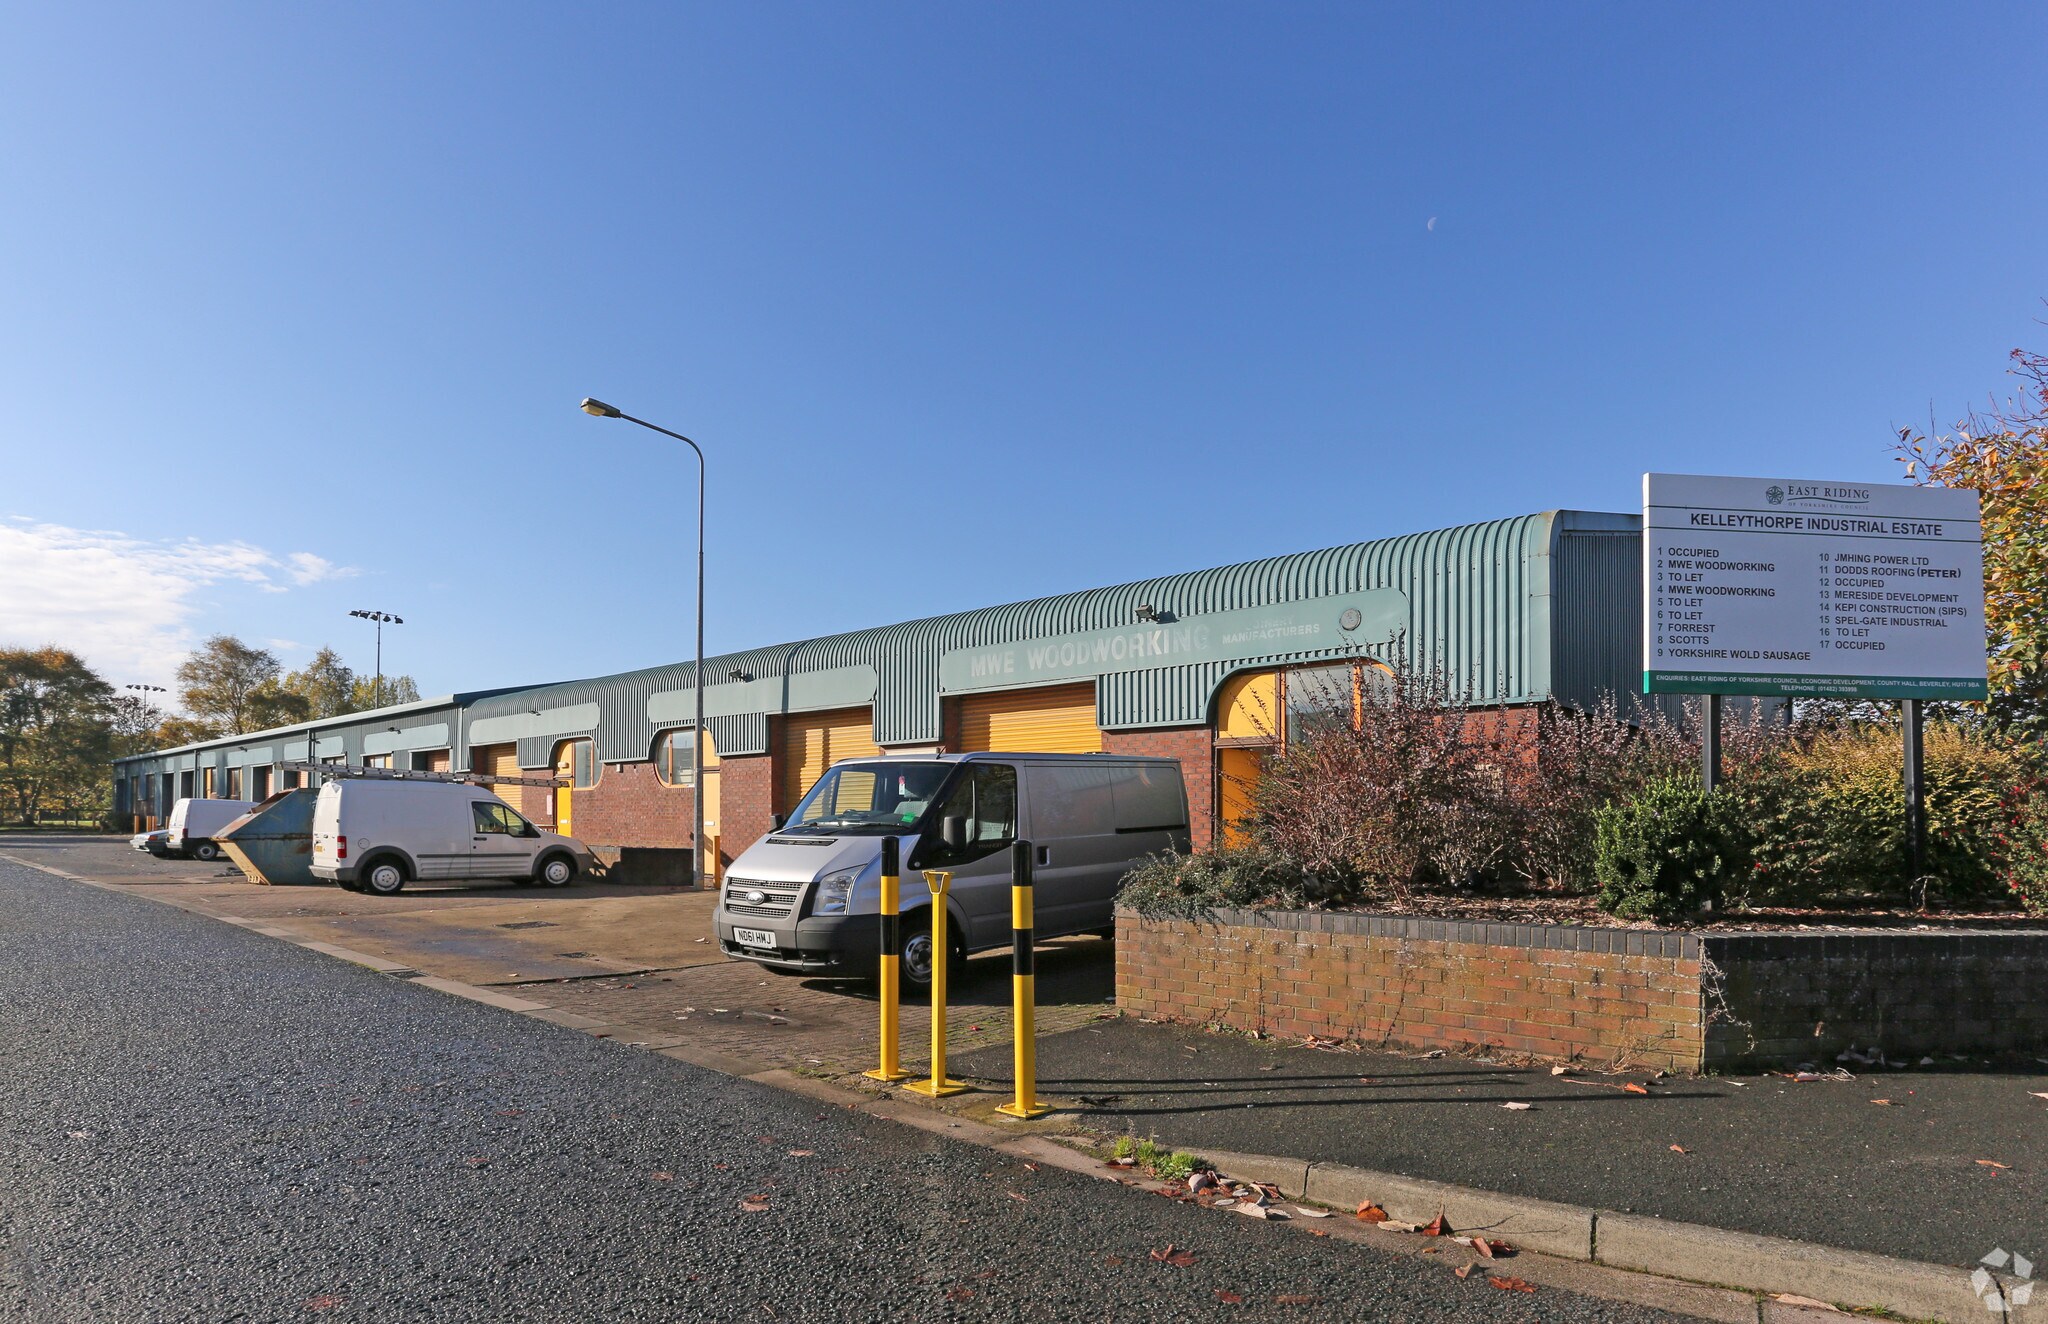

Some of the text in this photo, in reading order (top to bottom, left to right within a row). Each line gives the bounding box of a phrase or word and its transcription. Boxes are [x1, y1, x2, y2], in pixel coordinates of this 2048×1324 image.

[1788, 486, 1870, 500] EAST RIDING
[1691, 513, 1942, 536] KELLEYTHORPE INDUSTRIAL ESTATE
[1658, 547, 1719, 558] 1 OCCUPIED
[1820, 553, 1830, 561] 10
[1874, 555, 1909, 565] POWER
[1912, 557, 1929, 566] LTD
[1658, 560, 1775, 572] 2 MWE WOODWORKING
[1820, 566, 1961, 578] 11 DODDS ROOFING (PETER)
[1658, 573, 1703, 582] 3 TO LET
[1820, 578, 1884, 588] 12 OCCUPIED
[1668, 586, 1692, 594] MWE
[1695, 586, 1775, 597] WOODWORKING
[1820, 591, 1959, 603] 13 MERESIDE DEVELOPMENT
[1658, 598, 1703, 607] 5 TO LET
[1658, 610, 1703, 620] 6 TO LET
[1820, 603, 1967, 617] 14 KEPI CONSTRUCTION (SIPS)
[1658, 623, 1715, 633] 7 FORREST
[1820, 616, 1947, 628] 15 SPEL-GATE INDUSTRIAL
[1222, 624, 1320, 644] MANUFACTURERS
[1820, 628, 1869, 637] 16 TO LET
[1658, 636, 1709, 644] 8 SCOTTS
[1820, 641, 1885, 650] 17 OCCUPIED
[970, 624, 1210, 678] MWE WOODWORKING
[1658, 648, 1811, 661] 9 YORKSHIRE WOLD SAUSAGE
